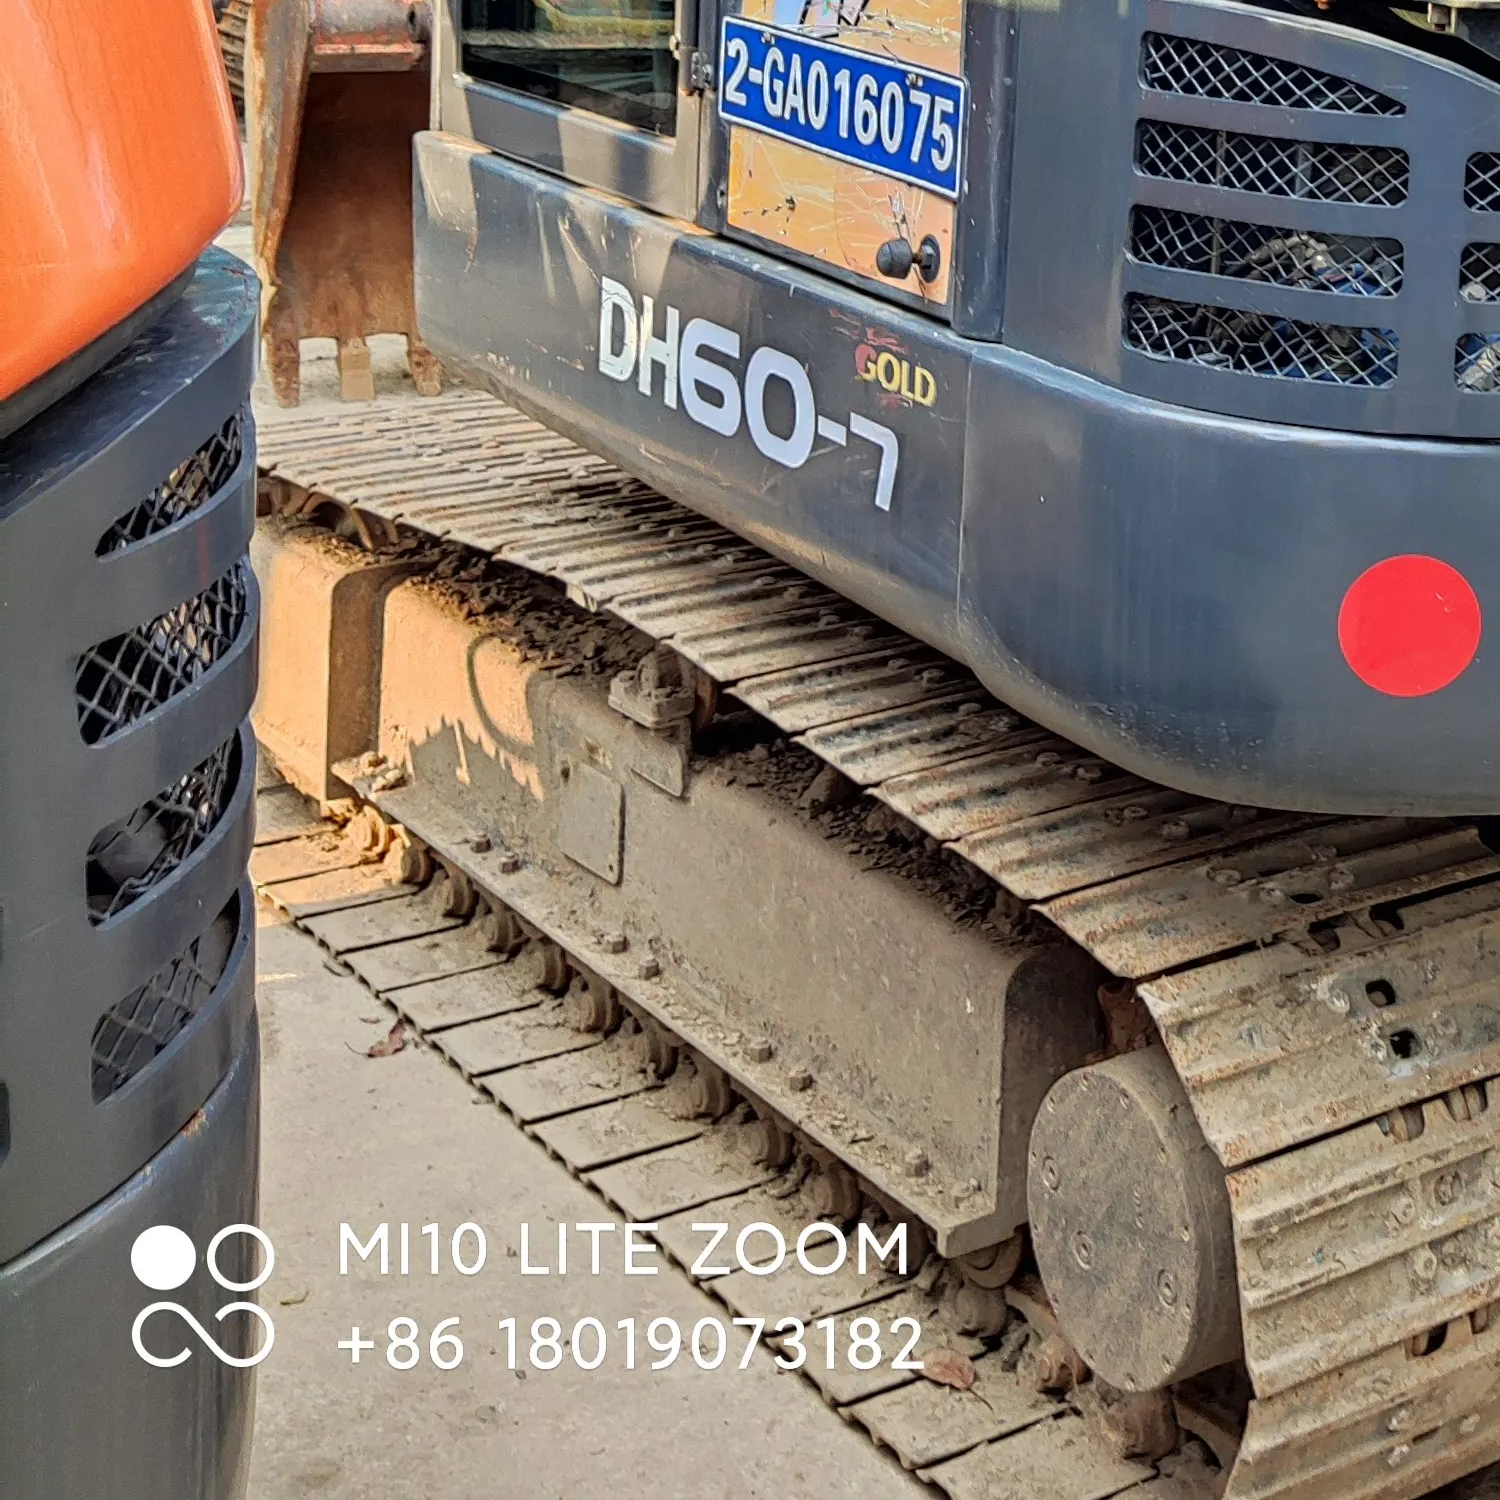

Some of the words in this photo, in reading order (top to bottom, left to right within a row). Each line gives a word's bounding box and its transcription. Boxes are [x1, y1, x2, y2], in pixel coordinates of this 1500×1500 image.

[724, 37, 955, 173] 2-GA016075
[598, 274, 901, 512] DH60-7
[854, 343, 938, 408] GOLD
